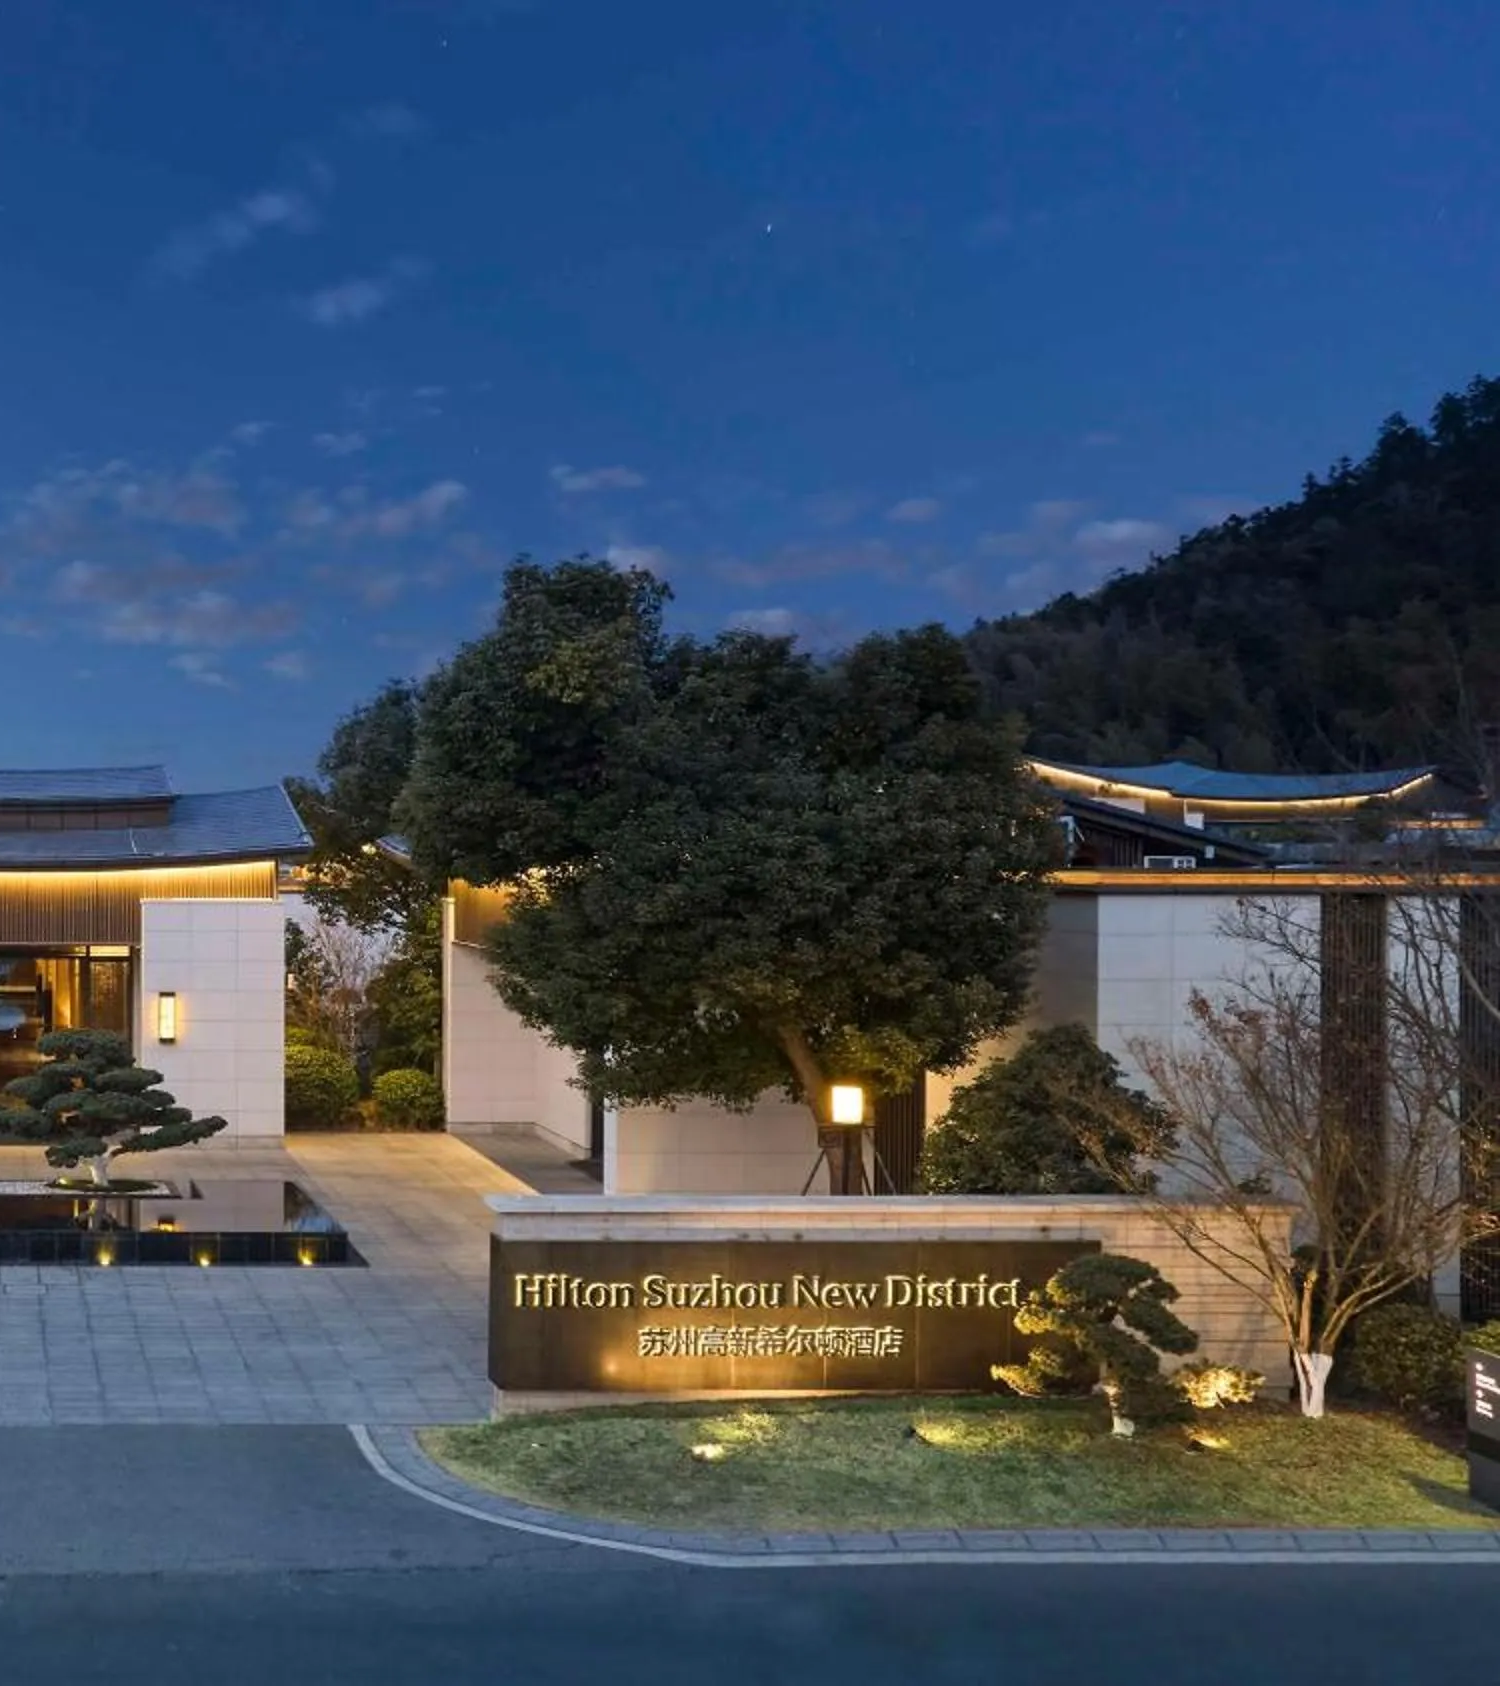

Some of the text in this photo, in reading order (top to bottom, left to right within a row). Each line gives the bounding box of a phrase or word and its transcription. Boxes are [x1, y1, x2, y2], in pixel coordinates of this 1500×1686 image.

[514, 1273, 1028, 1310] Hilton Suzhou New District
[636, 1323, 905, 1357] 苏州高新希尔顿酒店
